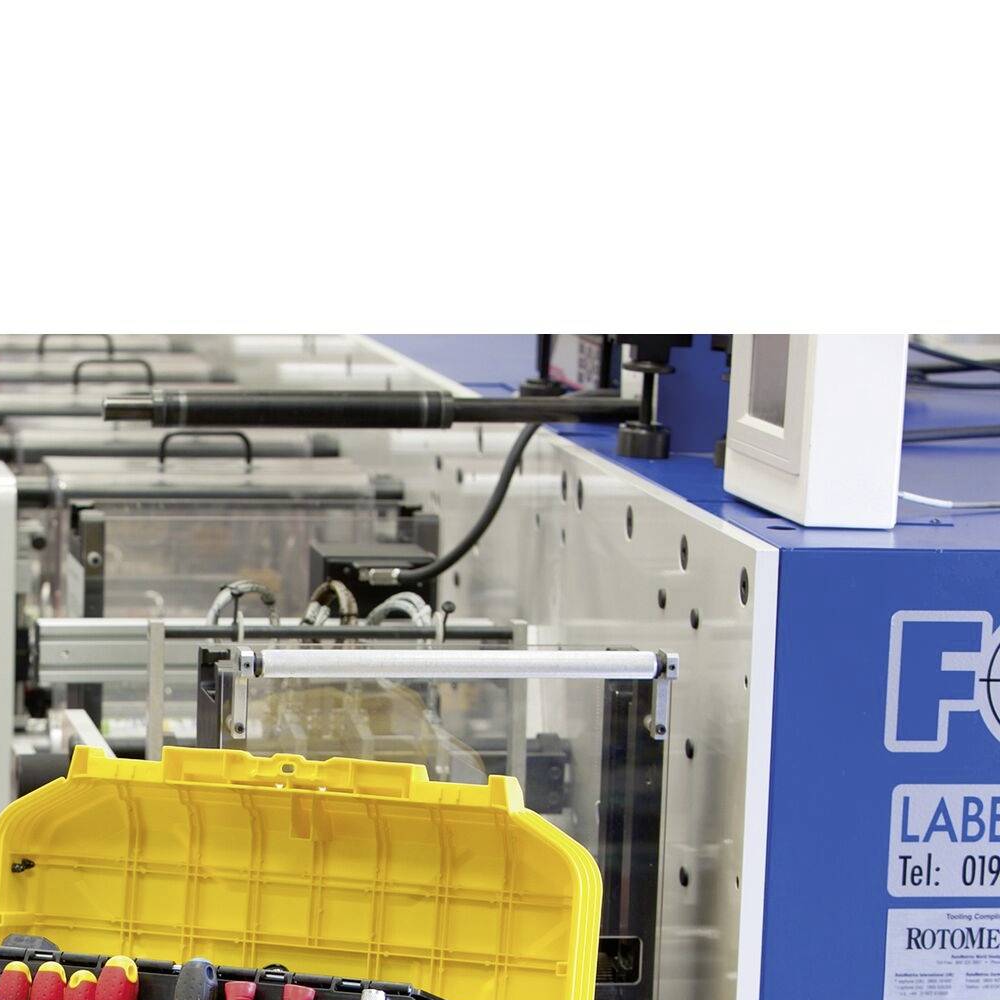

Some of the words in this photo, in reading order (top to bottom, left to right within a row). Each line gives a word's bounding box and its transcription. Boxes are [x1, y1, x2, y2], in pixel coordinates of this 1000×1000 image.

[900, 796, 1000, 843] LABE
[898, 853, 941, 887] Tel:
[962, 855, 1000, 886] 019
